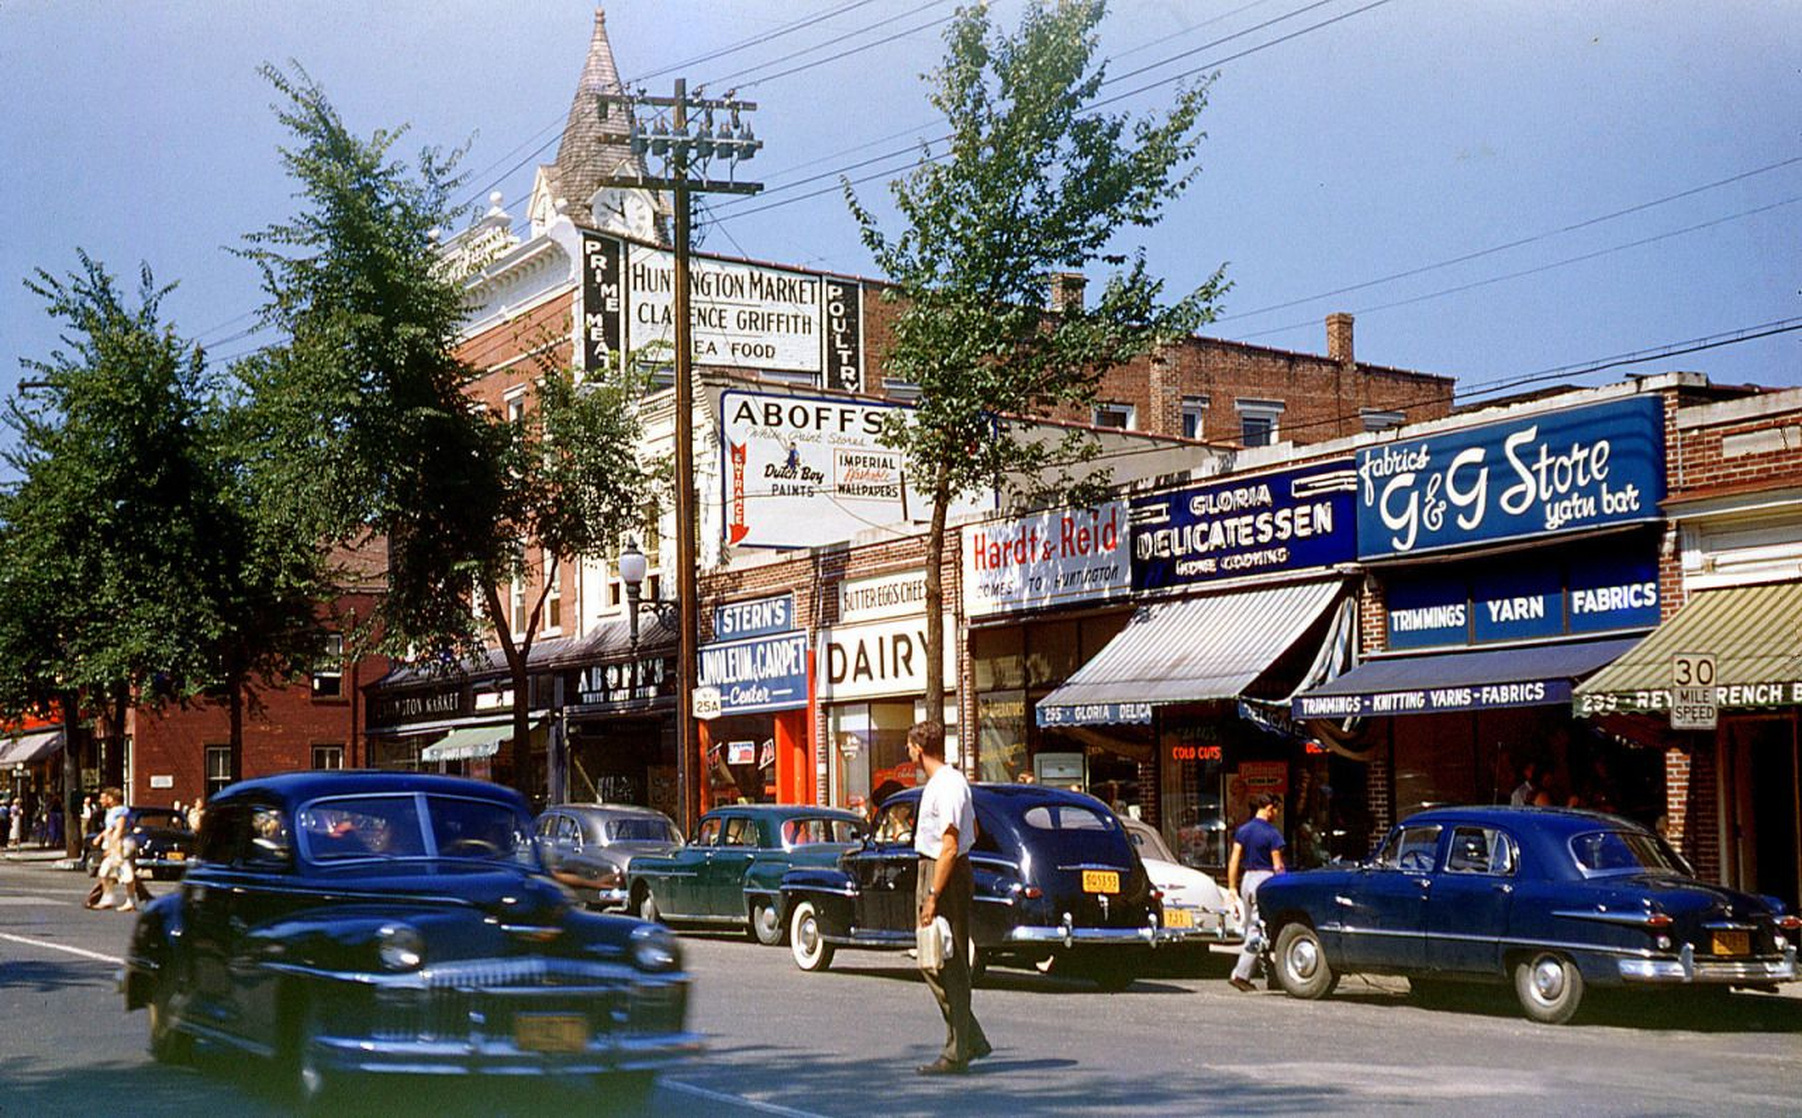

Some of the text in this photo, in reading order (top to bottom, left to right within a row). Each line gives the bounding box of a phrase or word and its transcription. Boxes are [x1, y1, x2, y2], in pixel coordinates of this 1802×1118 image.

[632, 263, 818, 305] HUNNGTON MARKET
[585, 241, 619, 370] PRIME MEAT
[638, 302, 812, 336] CLAENCE GRIFFITH
[694, 340, 776, 360] EA FOOD
[827, 285, 860, 394] POULTRY
[733, 401, 882, 435] ABOFF'S
[764, 463, 825, 485] Dutch Boy
[839, 455, 896, 470] IMPERIAL
[1500, 424, 1610, 514] Store
[772, 484, 815, 498] PAINTS
[837, 484, 899, 498] WALLPAPERS
[1190, 483, 1273, 517] GLORIA
[974, 508, 1118, 571] Hardt & Reid
[1137, 501, 1333, 561] DELICATESSEN
[1029, 577, 1043, 594] TO
[1054, 566, 1119, 590] HUNTINGTON
[1176, 558, 1217, 576] HOME
[844, 579, 924, 612] BUTTER EGGS CHEE
[1391, 583, 1657, 632] TRIMMINGS YARN FABRICS
[722, 599, 786, 633] STERN'S
[756, 638, 807, 680] CARPET
[1676, 658, 1714, 685] 30
[697, 700, 719, 713] 25A
[729, 685, 771, 705] Center
[1302, 683, 1545, 715] TRIMMINGS KNITTING YARNS FABRICS
[1636, 690, 1673, 708] REY
[1716, 685, 1783, 705] RENCH
[1680, 690, 1710, 703] MILE
[1045, 706, 1062, 722] 295
[1074, 704, 1110, 721] GLORIA
[1118, 702, 1152, 719] DELICA
[1675, 705, 1714, 721] SPEED
[1172, 745, 1222, 761] COLD CUTS
